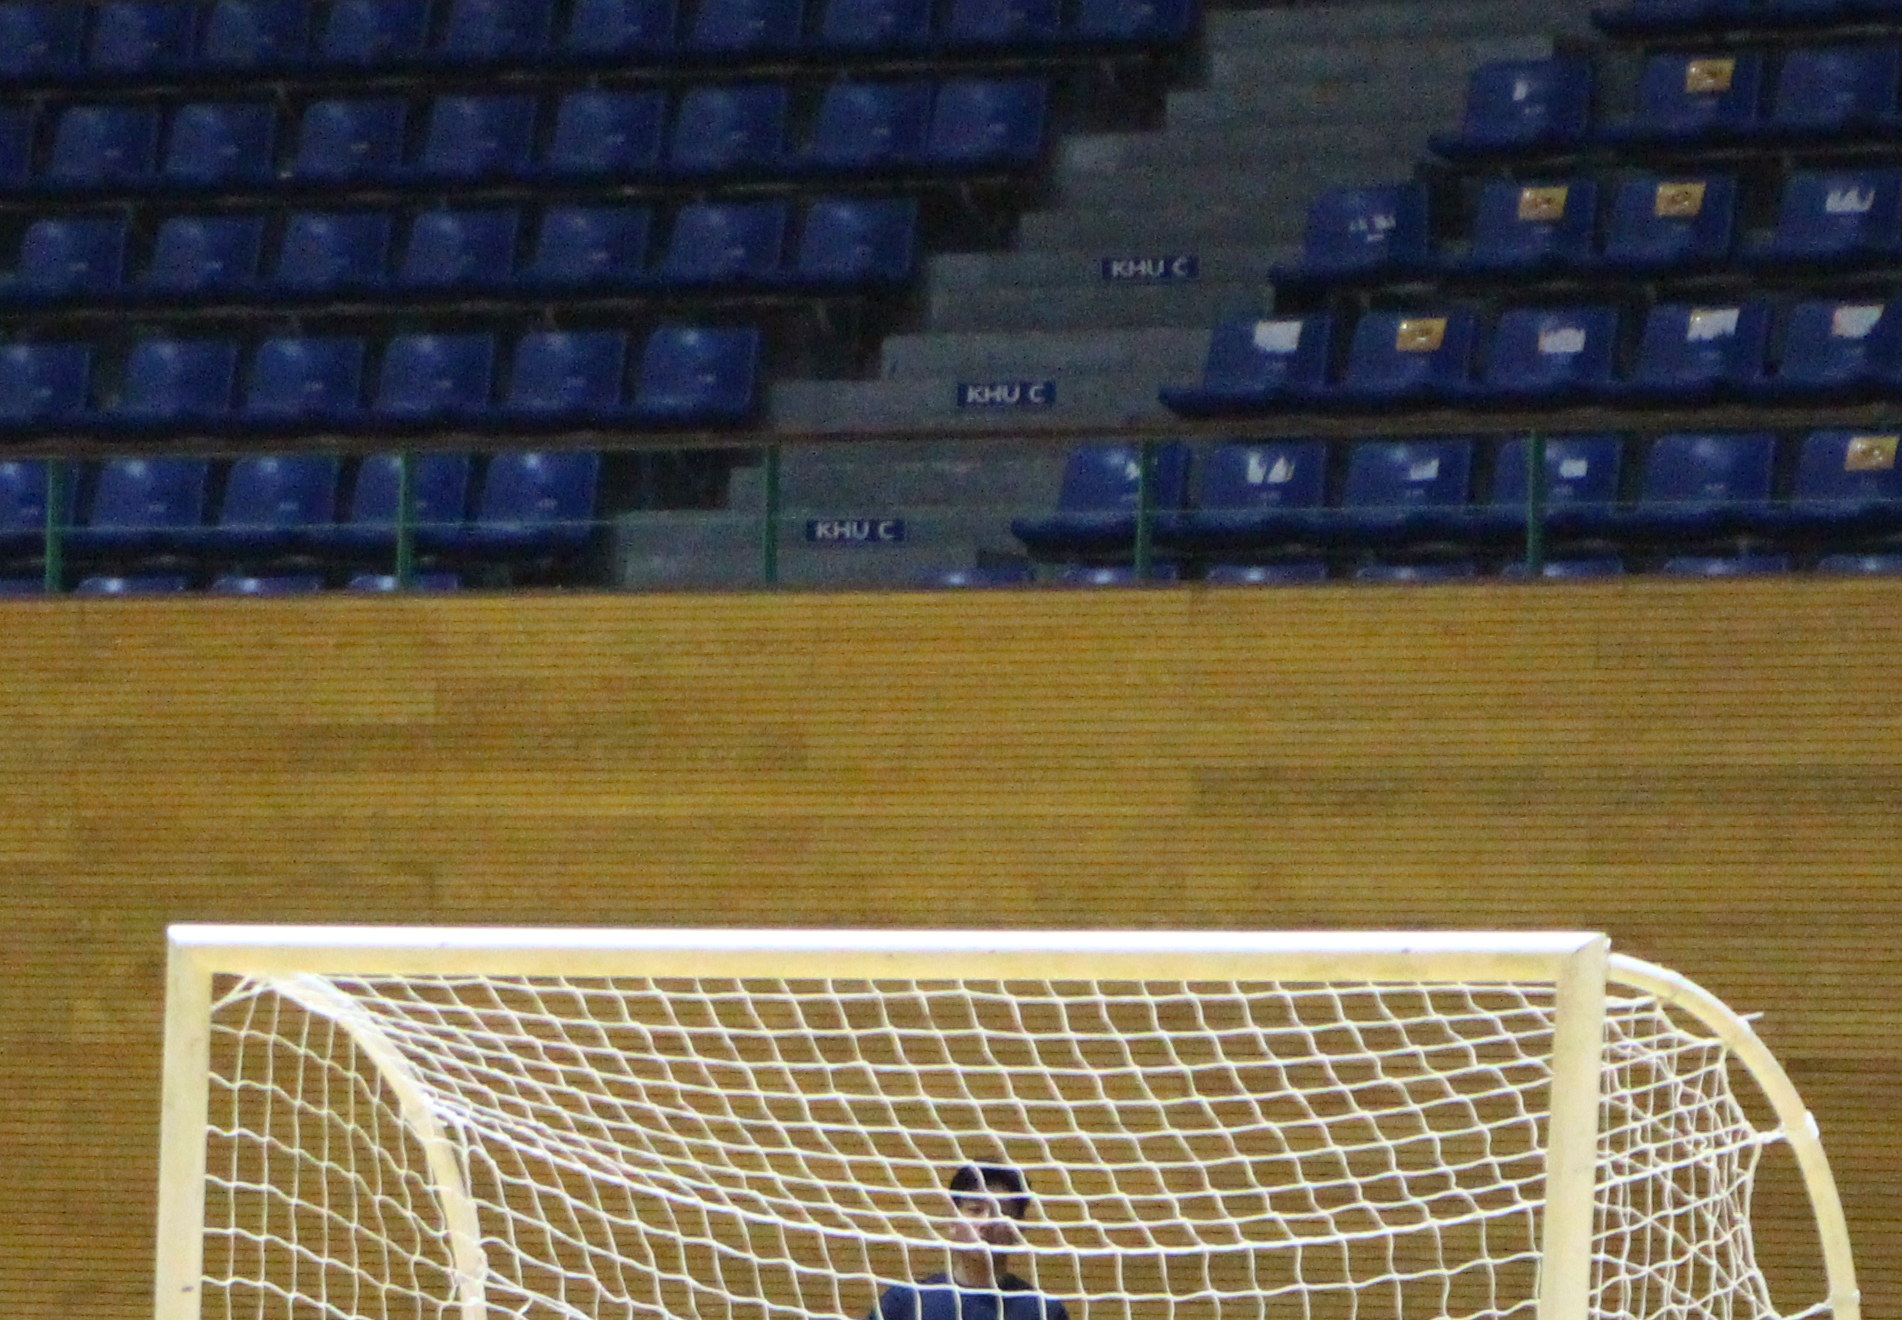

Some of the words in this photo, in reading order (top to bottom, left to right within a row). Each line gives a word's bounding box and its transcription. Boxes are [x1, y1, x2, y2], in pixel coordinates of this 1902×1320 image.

[1111, 258, 1165, 279] KHU
[966, 384, 1021, 403] KHU
[1028, 384, 1046, 403] C
[815, 520, 869, 539] KHU
[878, 520, 896, 540] C
